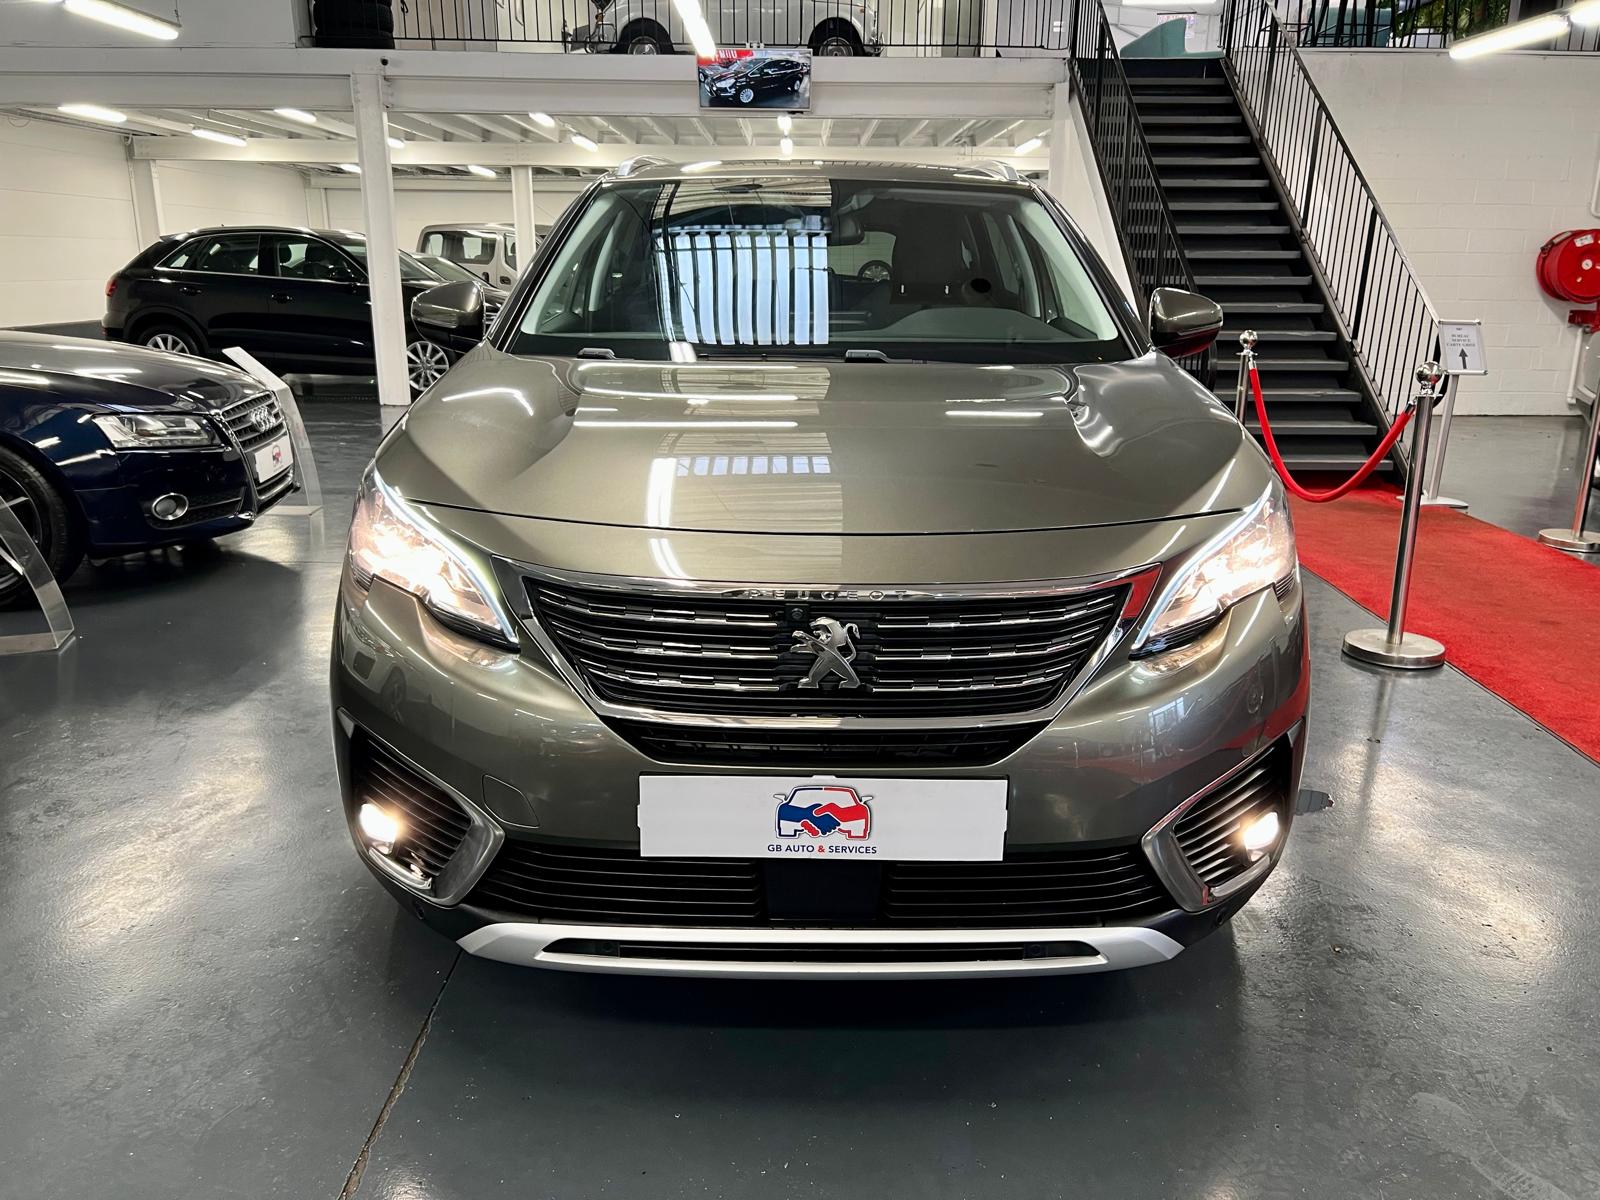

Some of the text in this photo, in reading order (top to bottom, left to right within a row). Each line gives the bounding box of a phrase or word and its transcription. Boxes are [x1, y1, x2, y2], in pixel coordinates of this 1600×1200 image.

[748, 589, 908, 601] PEUGEOT
[767, 844, 877, 854] GB AUTO & SERVICES
